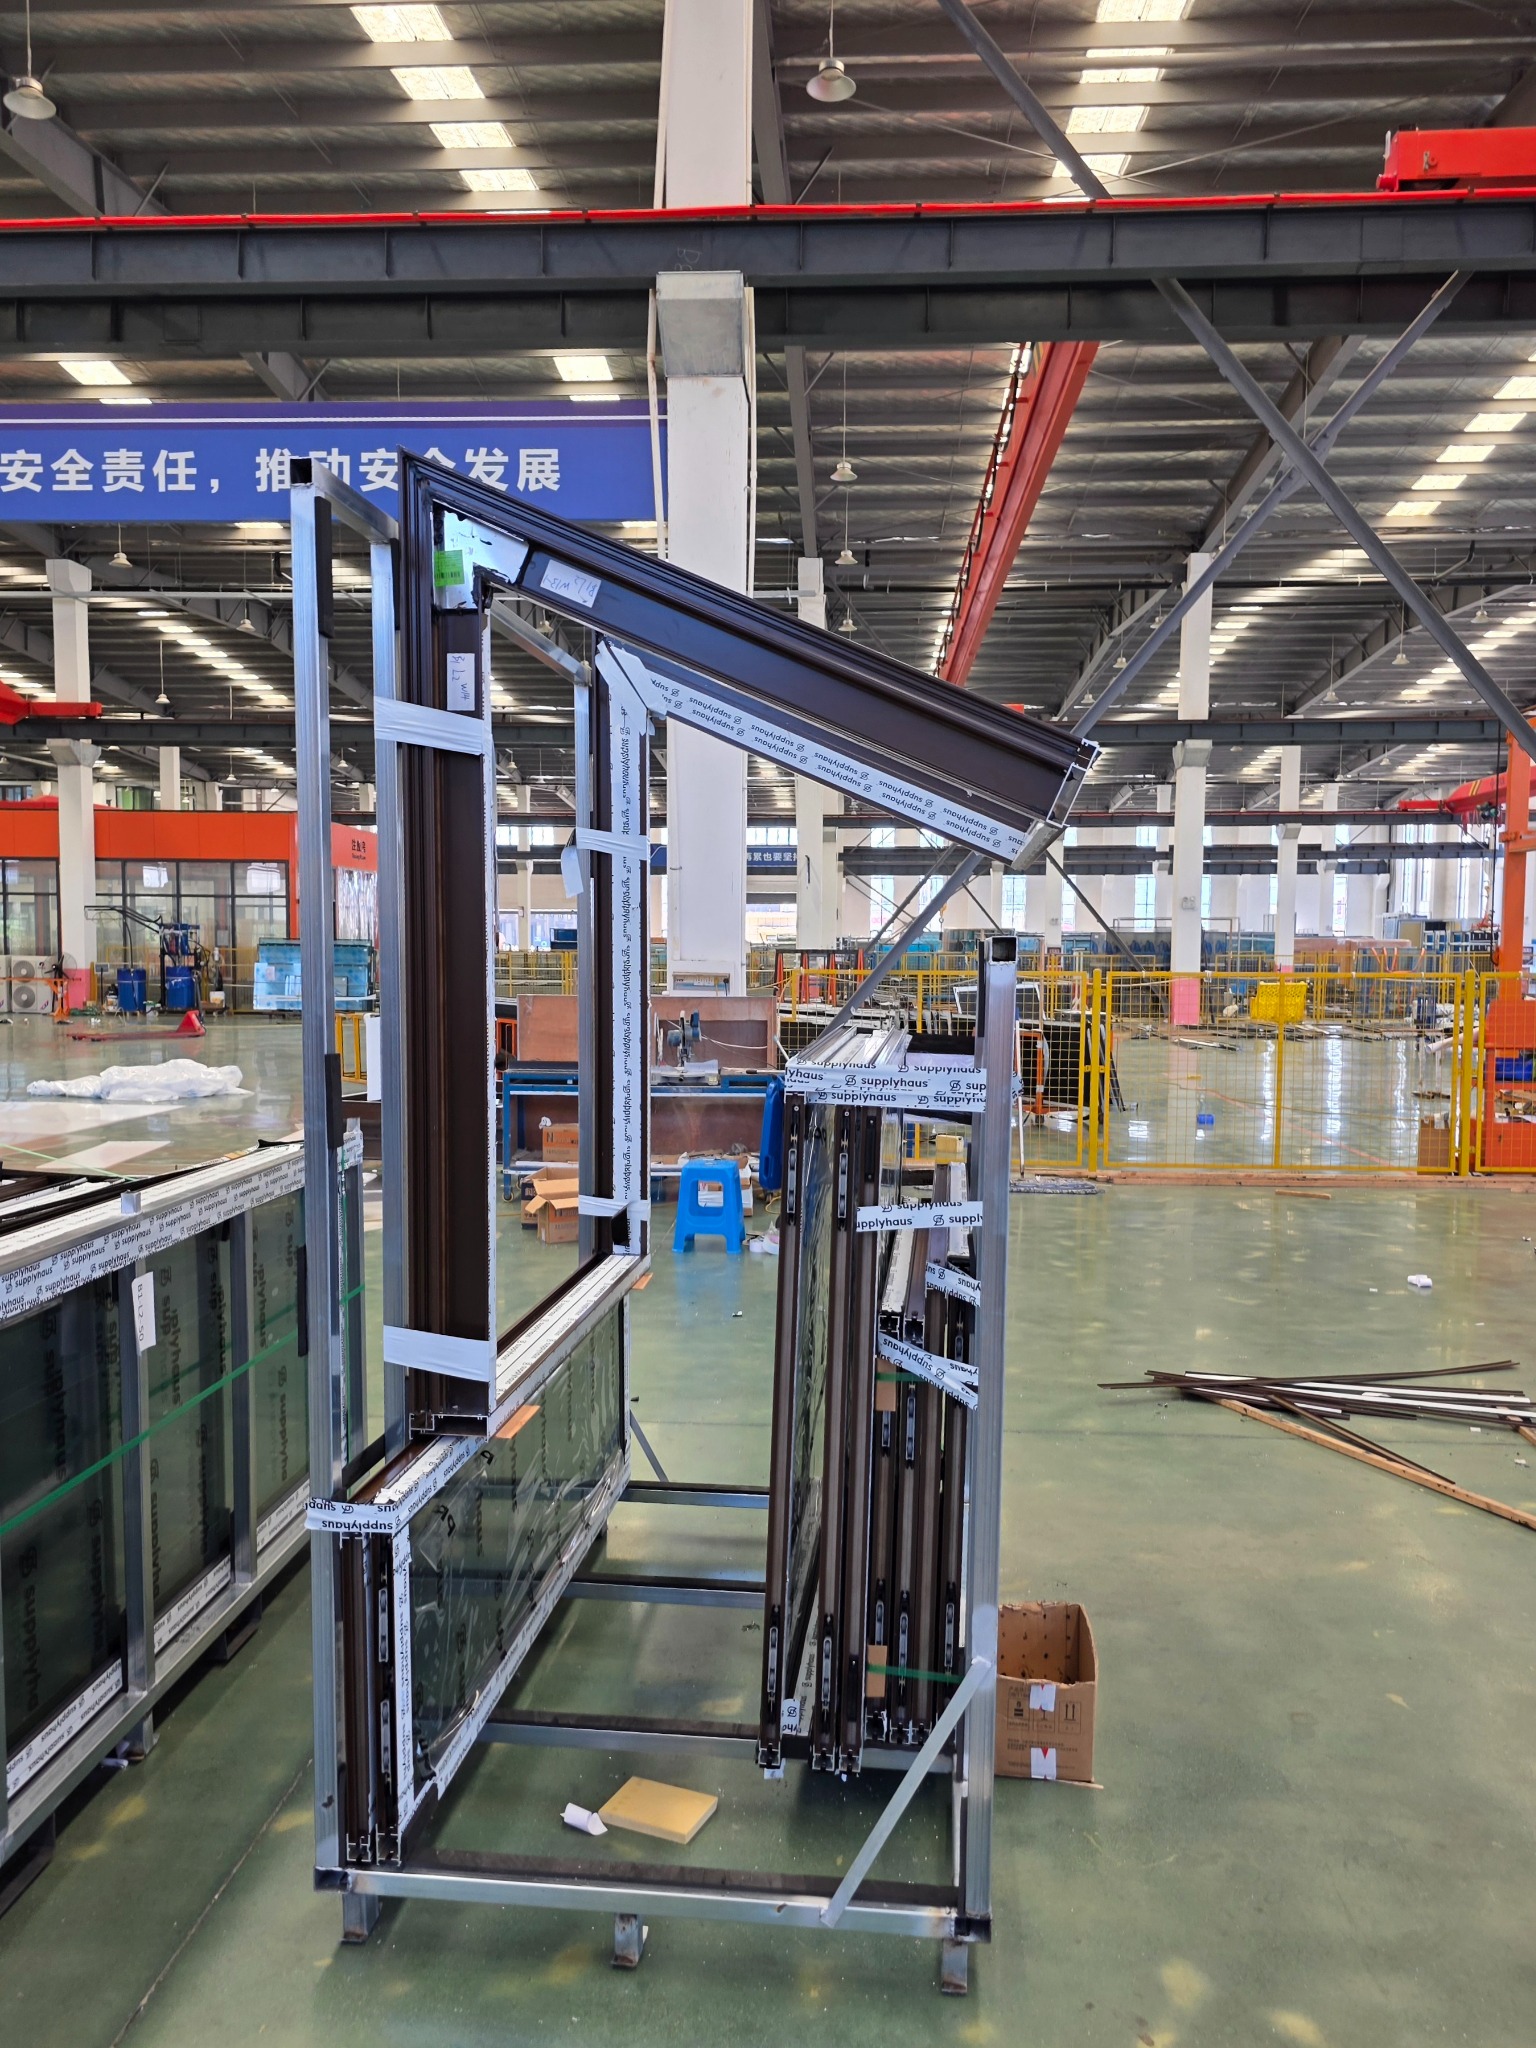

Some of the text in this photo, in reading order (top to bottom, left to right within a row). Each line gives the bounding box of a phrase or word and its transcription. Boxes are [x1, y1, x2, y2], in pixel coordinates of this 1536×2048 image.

[689, 696, 732, 720] supplyhaus
[692, 709, 735, 731] supplyhaus
[751, 724, 795, 747] supplyhaus
[754, 736, 797, 759] supplyhaus
[813, 751, 858, 776] supplyhaus
[817, 764, 861, 788] supplyhaus
[878, 779, 923, 803] supplyhaus
[881, 792, 926, 815] supplyhaus
[943, 807, 988, 831] supplyhaus
[946, 819, 990, 843] supplyhaus
[861, 1077, 928, 1089] supplyhaus
[1, 1262, 41, 1283] supplyhaus
[60, 1242, 94, 1260] supplyhaus
[111, 1223, 141, 1240] supplyhaus
[14, 1266, 53, 1288] supplyhaus
[72, 1246, 105, 1265] supplyhaus
[122, 1229, 152, 1246] supplyhaus
[882, 1338, 933, 1371] supplyhaus
[322, 1520, 393, 1530] supplyhaus
